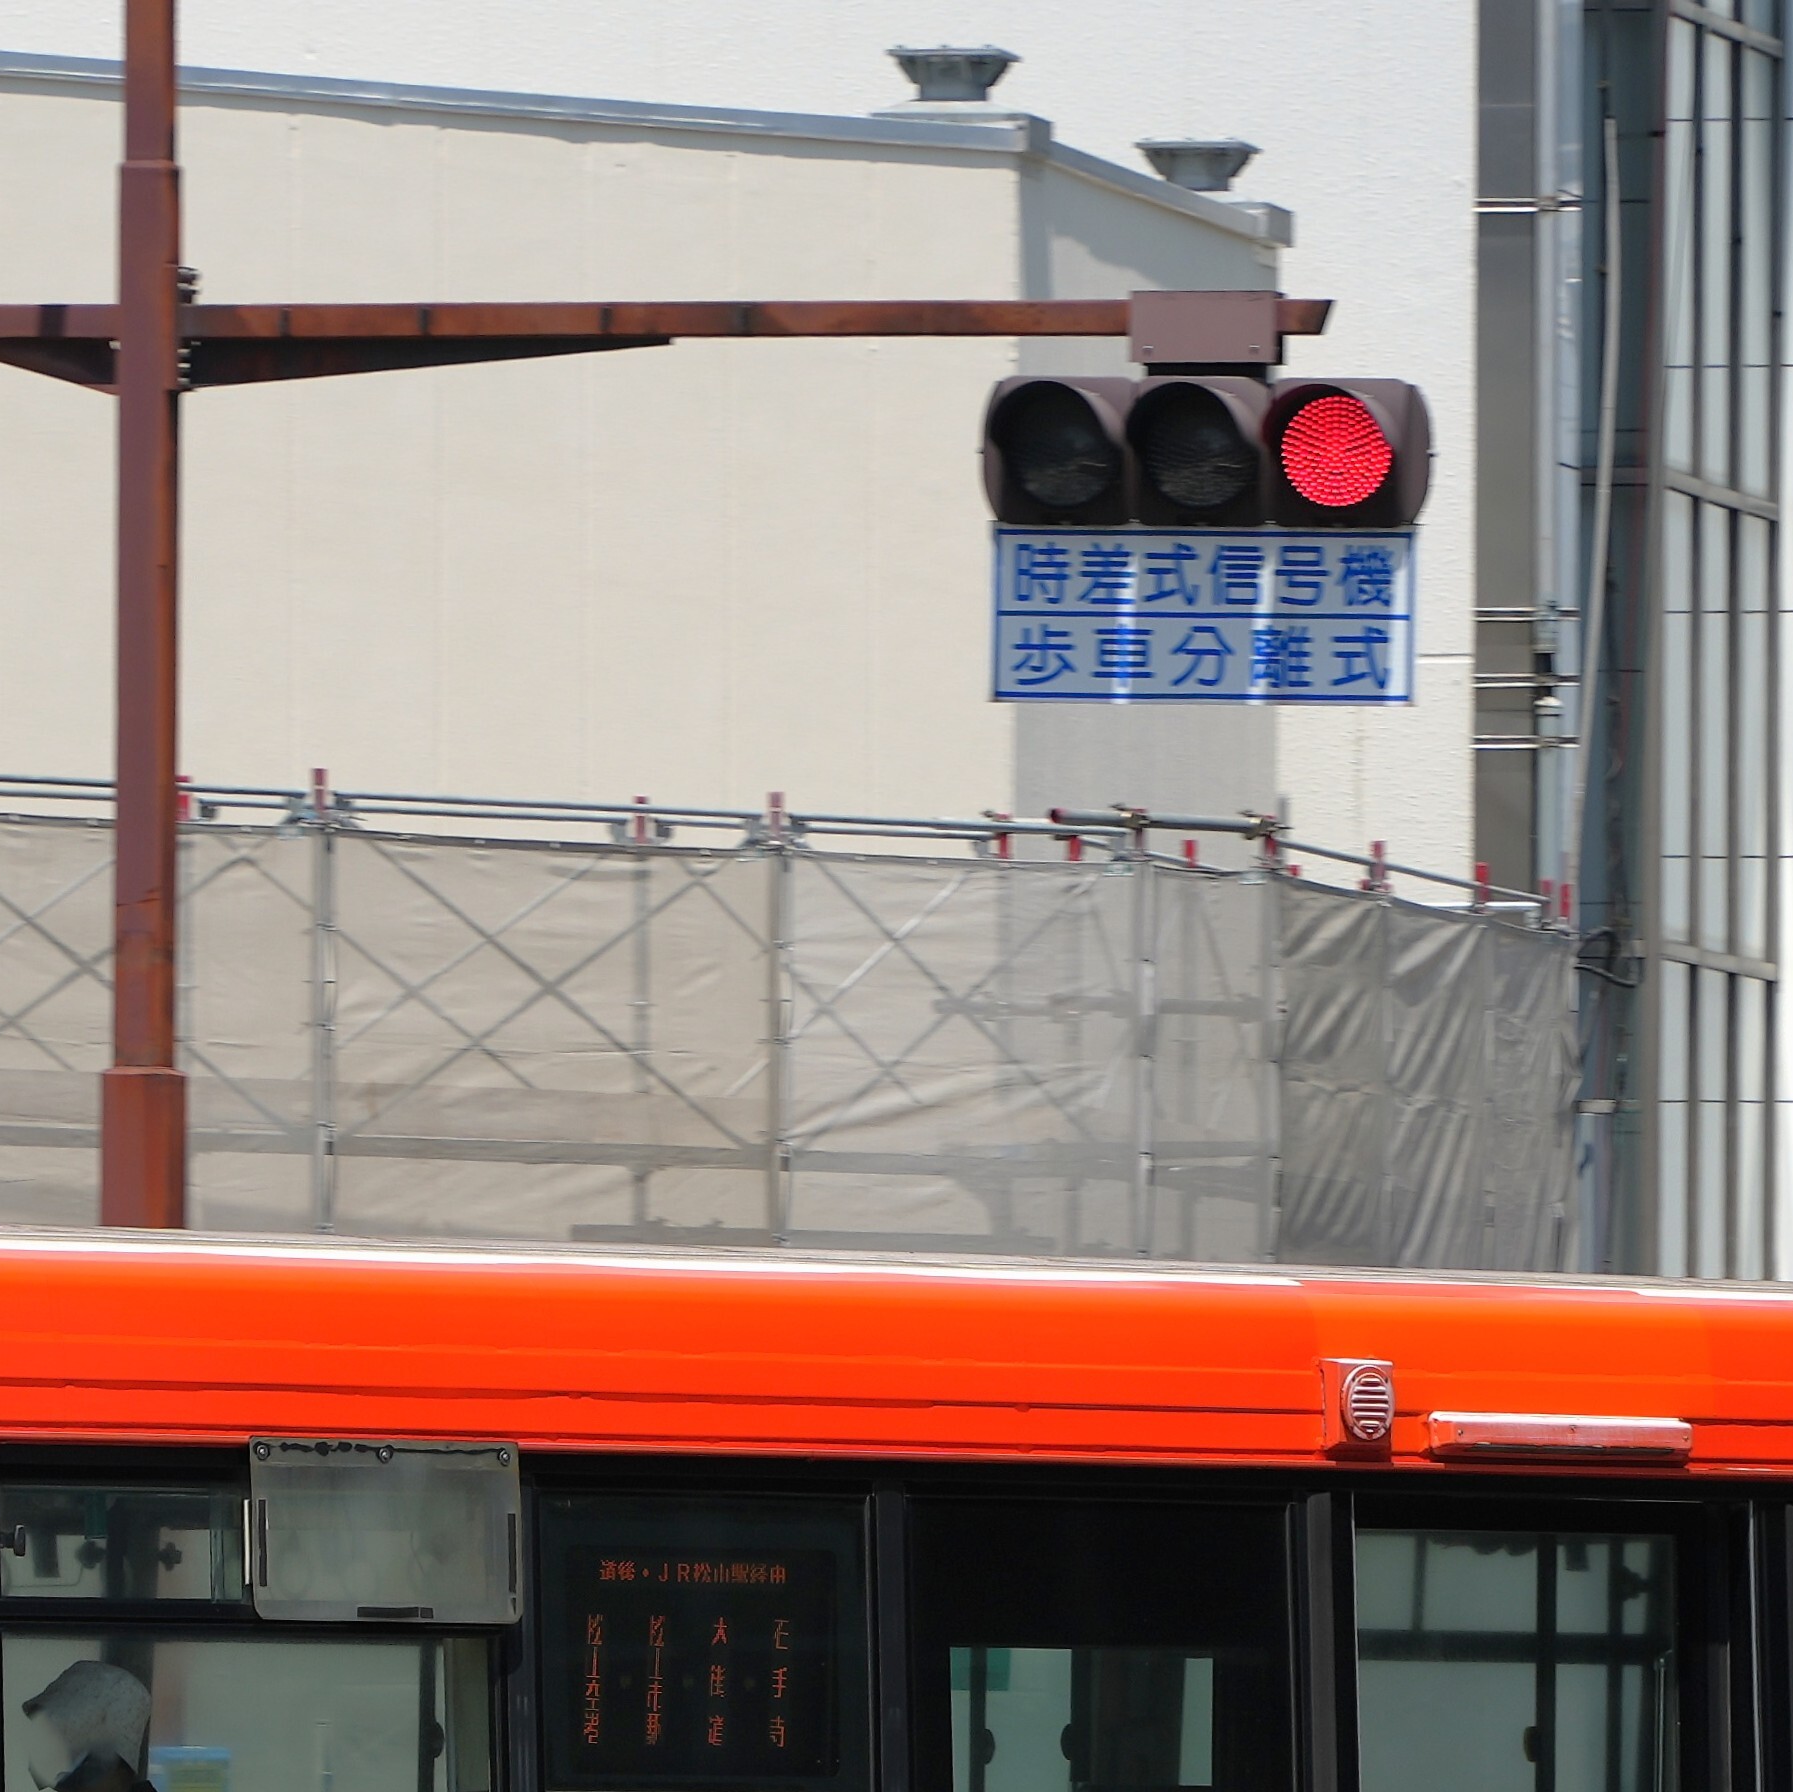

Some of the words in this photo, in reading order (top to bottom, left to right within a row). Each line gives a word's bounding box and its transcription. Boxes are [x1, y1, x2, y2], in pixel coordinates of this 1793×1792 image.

[1014, 542, 1396, 607] 時差式信号機
[1012, 624, 1392, 689] 歩車分離式
